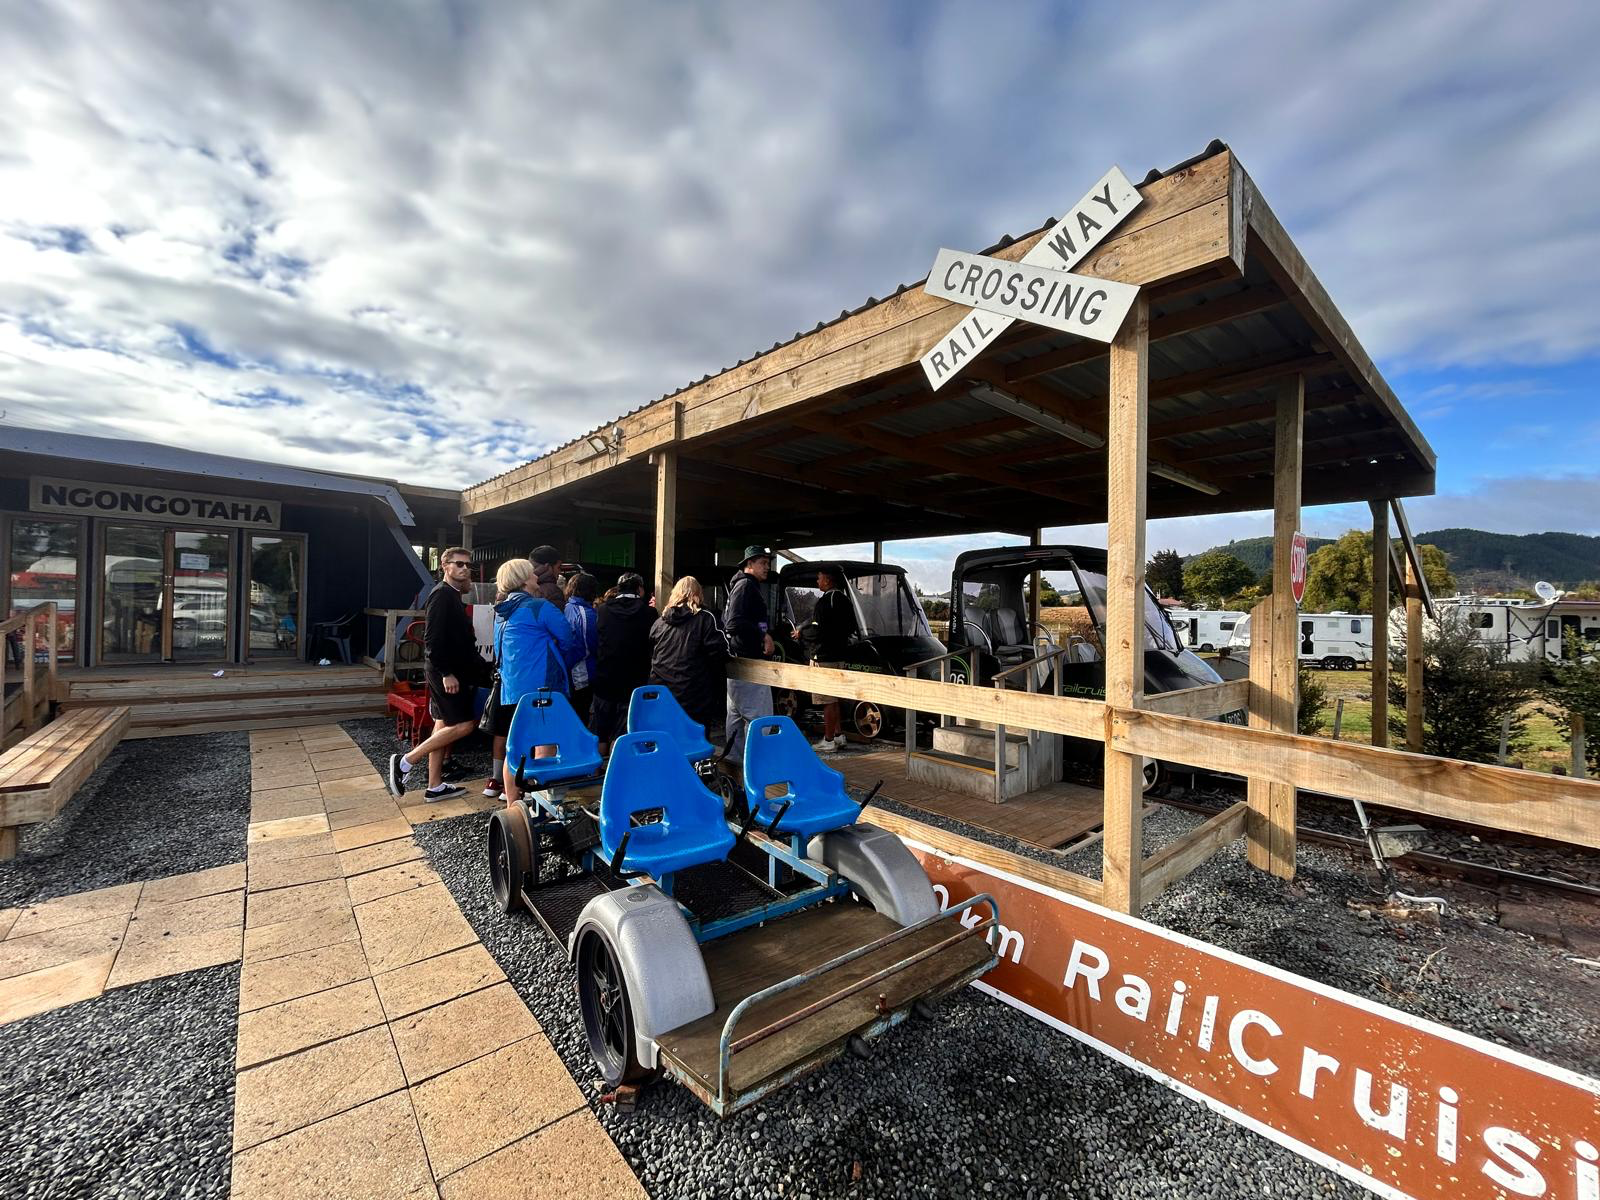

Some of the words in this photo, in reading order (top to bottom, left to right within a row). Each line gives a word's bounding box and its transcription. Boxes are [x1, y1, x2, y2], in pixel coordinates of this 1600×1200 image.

[943, 260, 1108, 326] CROSSING
[930, 316, 994, 378] RAIL
[41, 485, 273, 524] NGONGOTAHA
[1292, 544, 1306, 584] STOP
